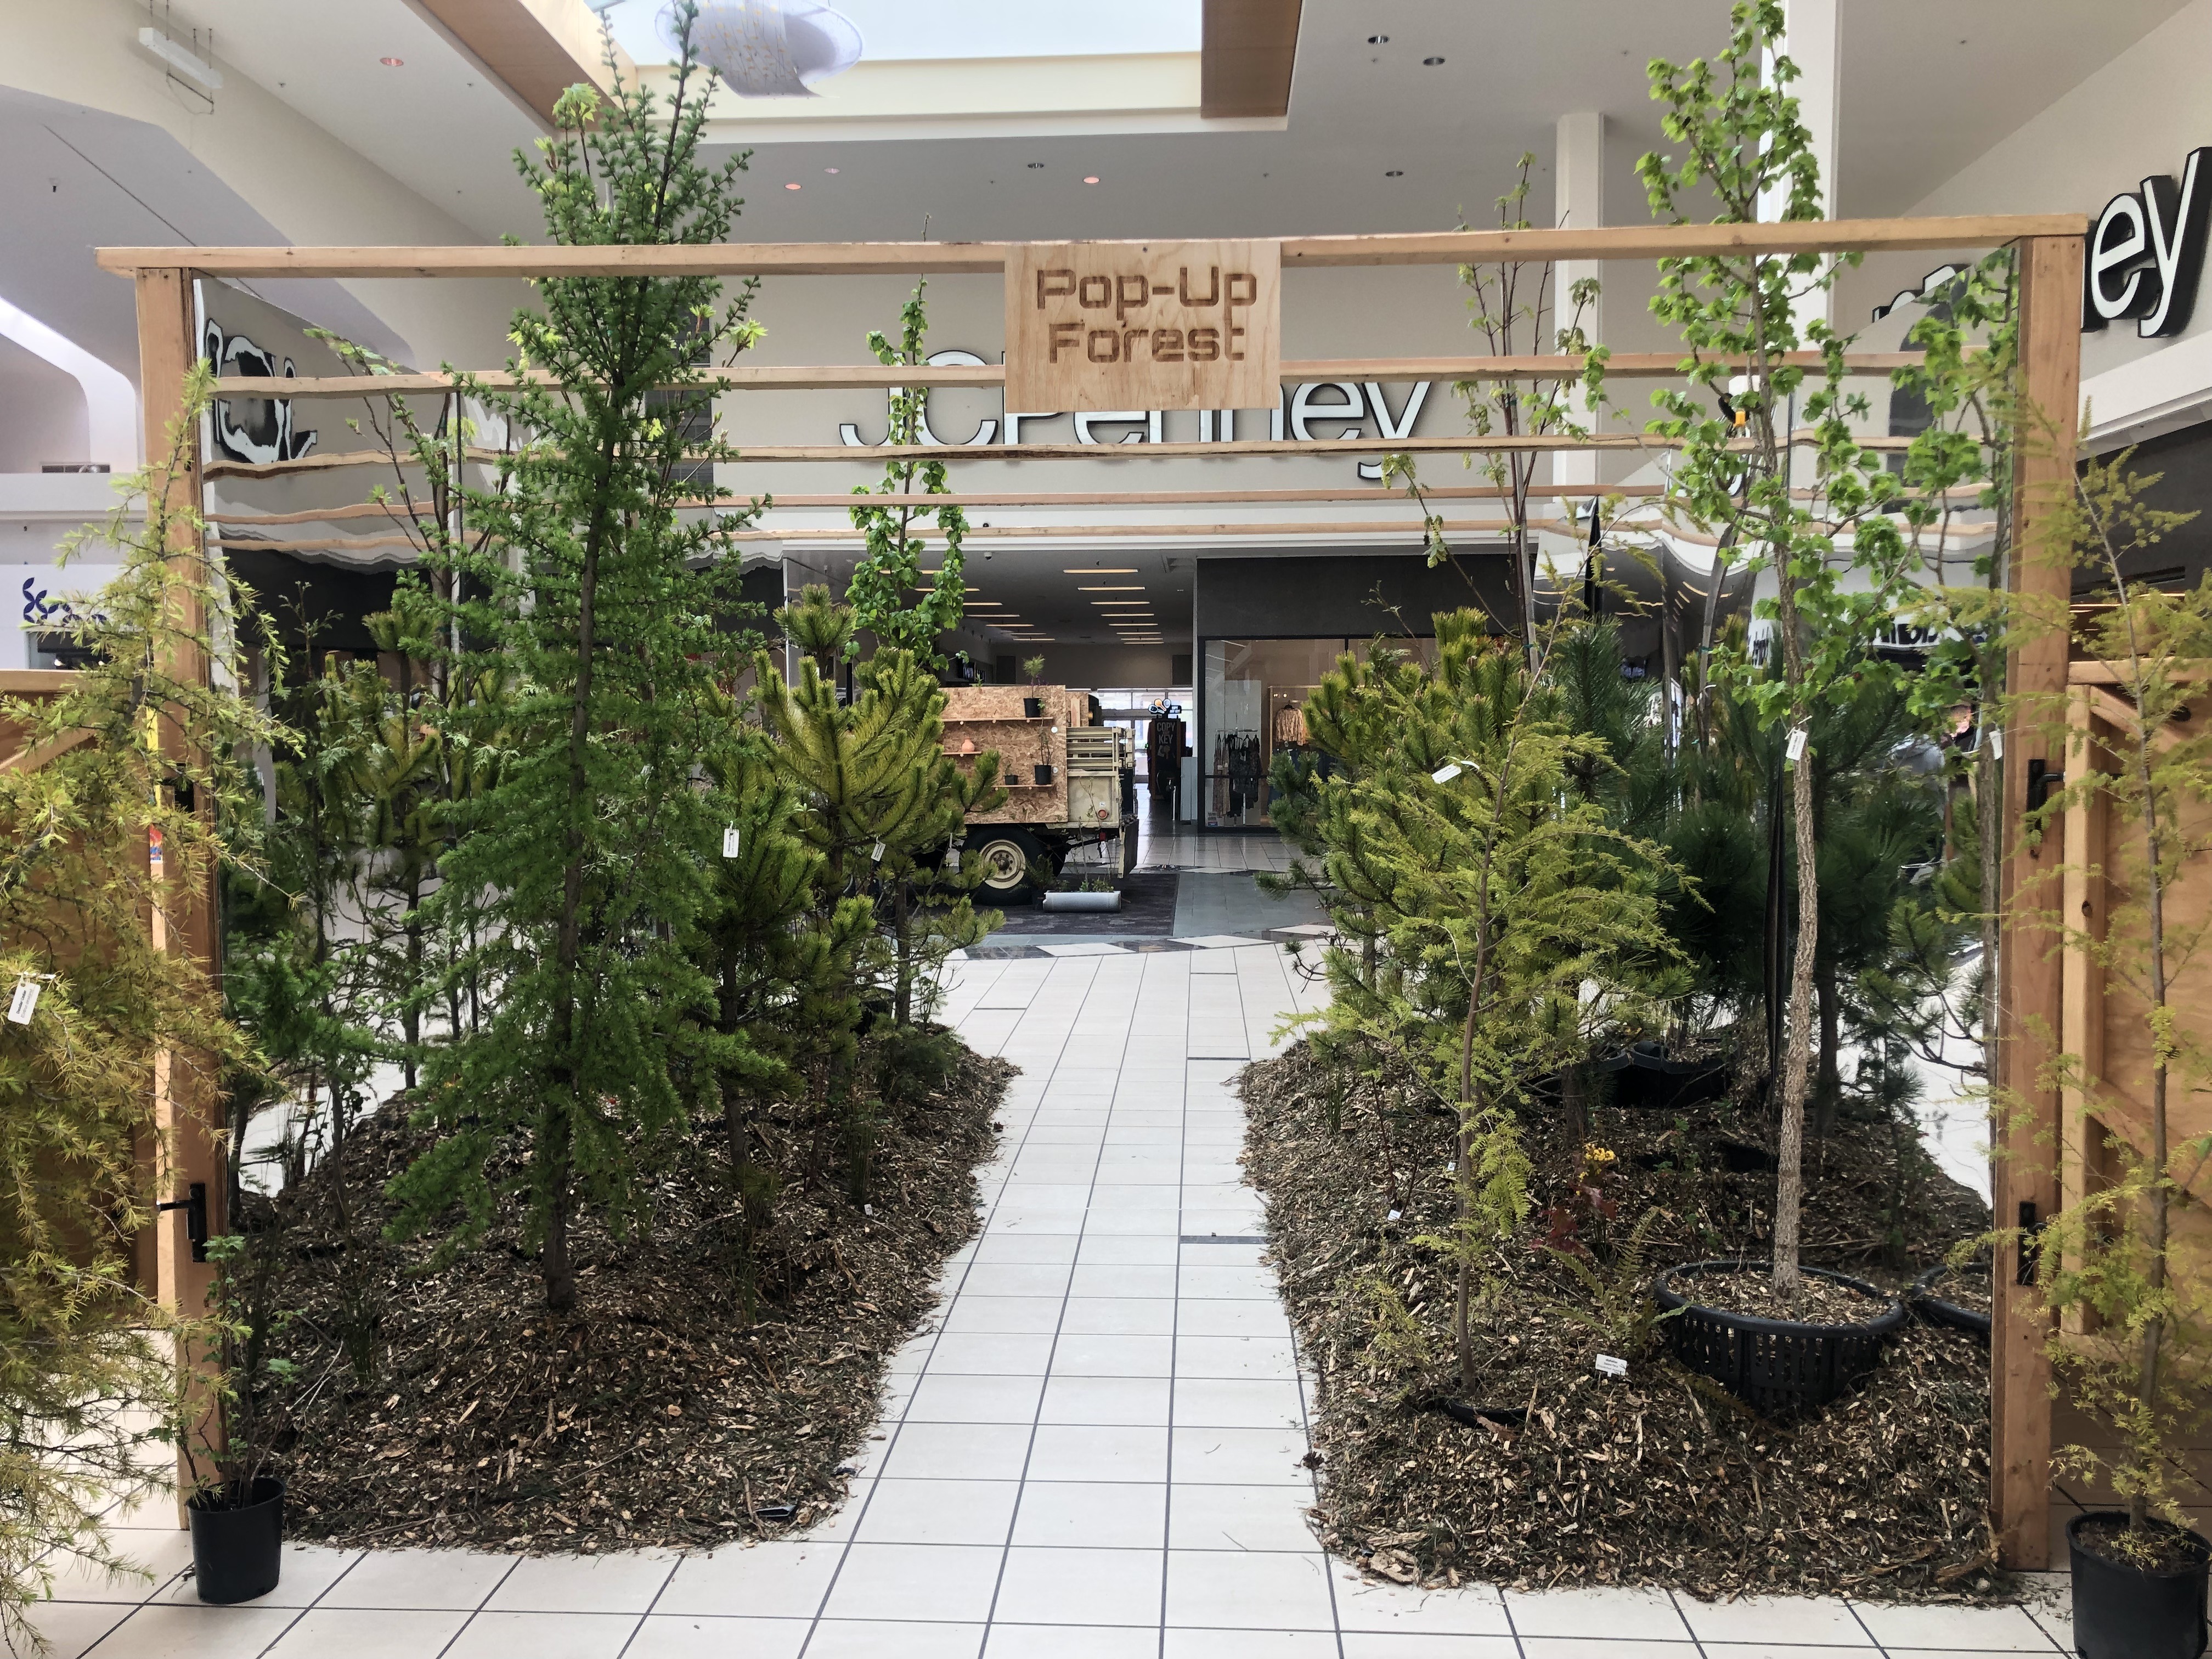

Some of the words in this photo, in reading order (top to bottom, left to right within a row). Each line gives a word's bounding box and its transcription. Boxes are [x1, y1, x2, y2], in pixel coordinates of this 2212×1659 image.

[1037, 266, 1257, 321] Pop-Up
[1049, 321, 1244, 364] Forest
[1156, 722, 1175, 732] COPY
[1159, 734, 1173, 744] KEY
